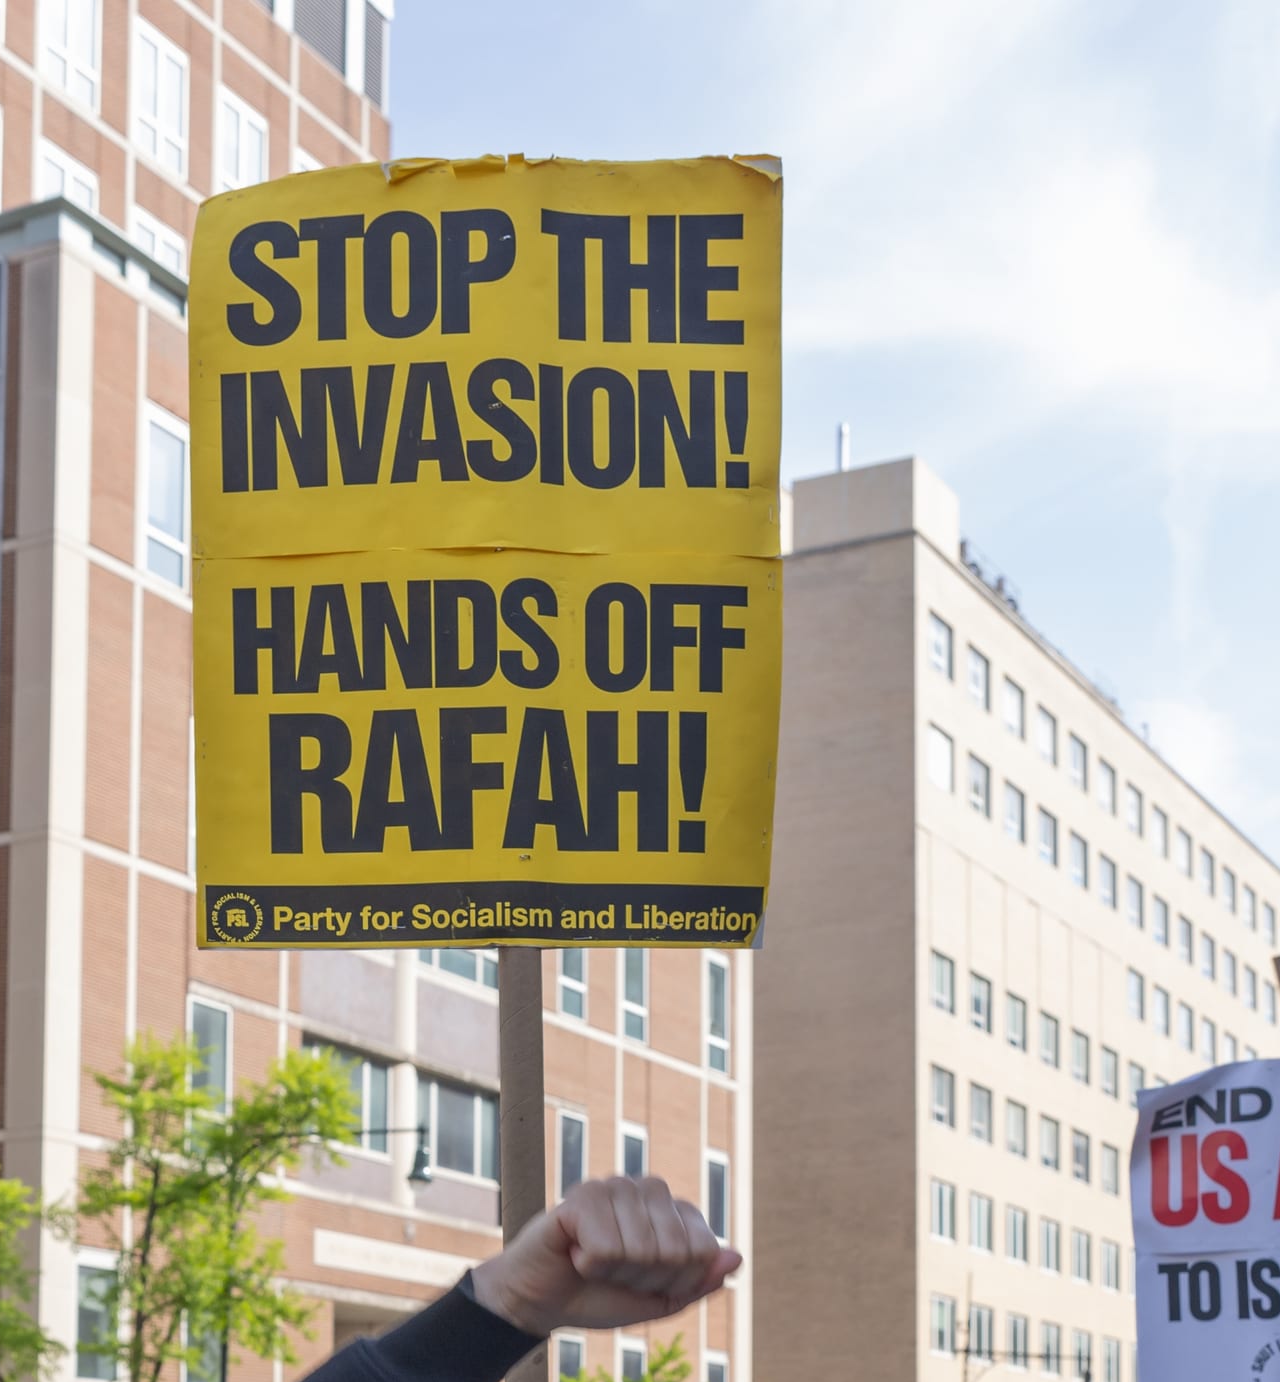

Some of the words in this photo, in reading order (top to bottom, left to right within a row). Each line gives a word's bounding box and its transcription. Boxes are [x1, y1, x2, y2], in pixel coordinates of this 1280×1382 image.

[226, 209, 517, 346] STOP
[540, 208, 745, 345] THE
[219, 357, 751, 493] INVASION!
[231, 577, 561, 695] HANDS
[584, 582, 749, 694] OFF
[267, 706, 708, 855] RAFAH!
[225, 908, 250, 928] PSL
[273, 906, 353, 937] Party
[360, 905, 404, 931] for
[411, 901, 554, 930] Socialism
[560, 904, 616, 930] and
[625, 904, 757, 932] Liberation
[1150, 1086, 1273, 1134] END
[1149, 1130, 1251, 1228] US
[1157, 1260, 1223, 1322] TO
[1251, 1342, 1275, 1373] SHUT
